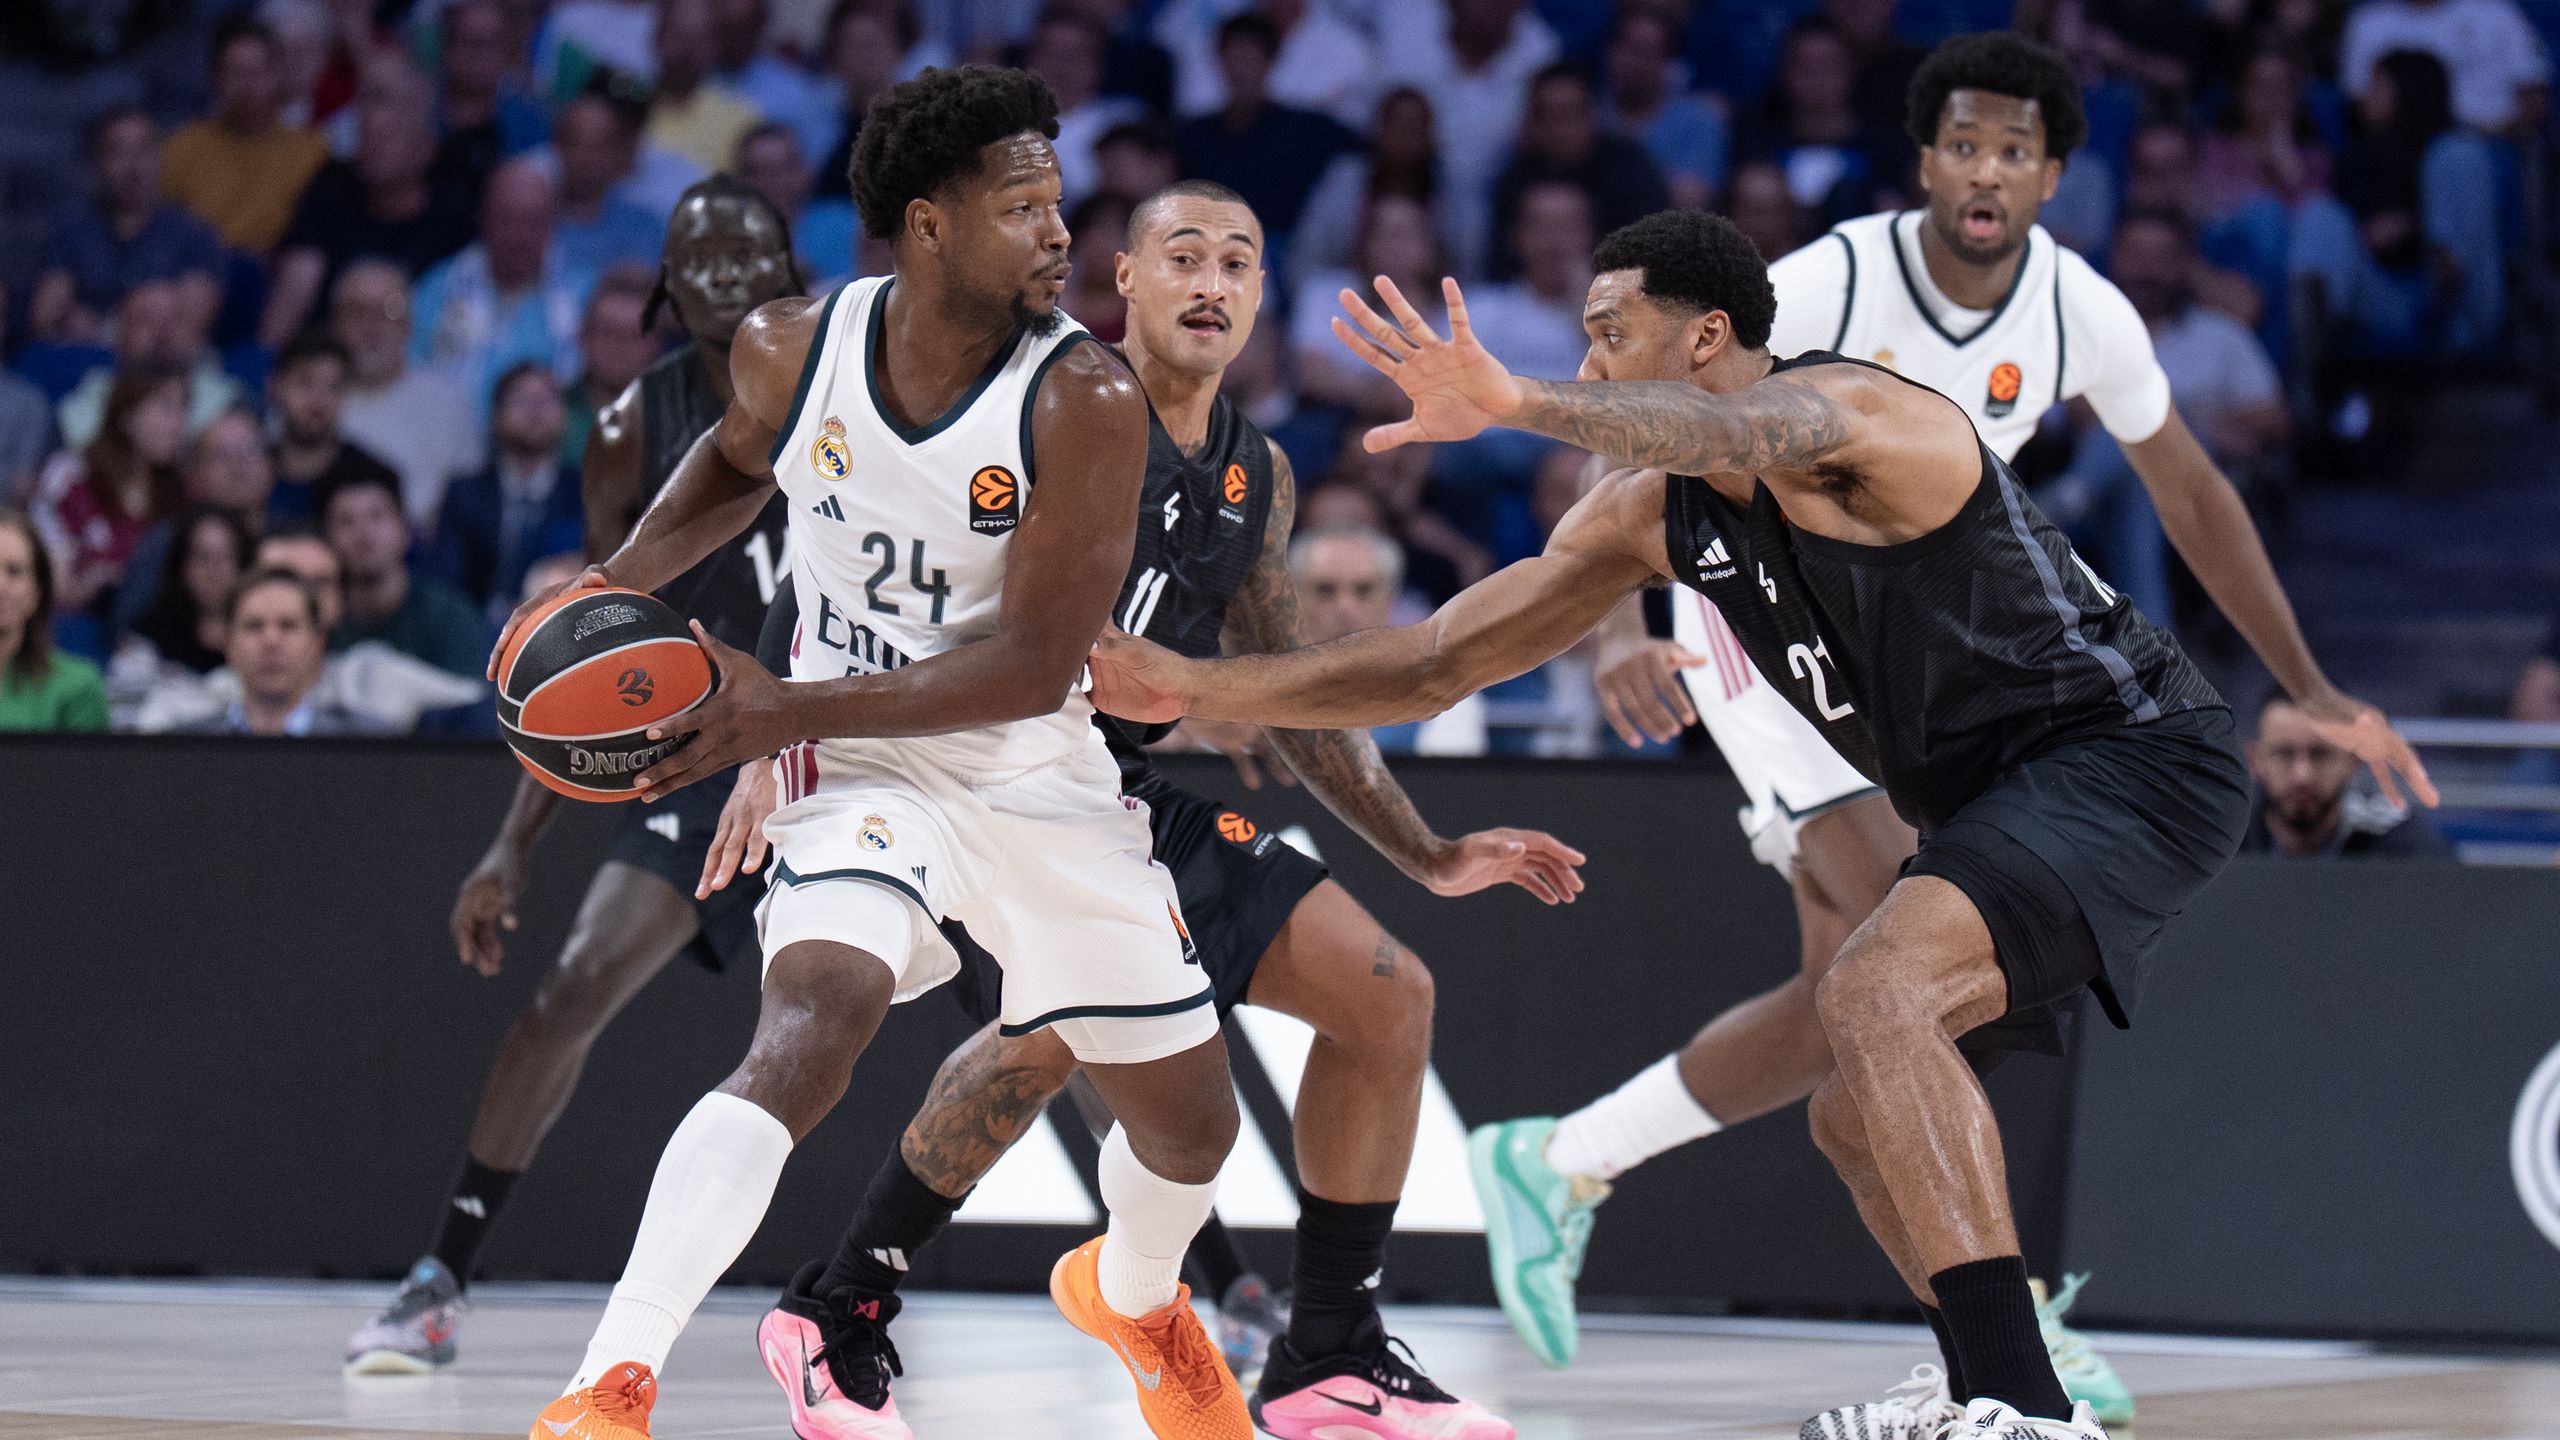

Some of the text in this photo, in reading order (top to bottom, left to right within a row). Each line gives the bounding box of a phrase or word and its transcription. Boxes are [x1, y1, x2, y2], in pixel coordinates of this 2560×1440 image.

[972, 519, 1016, 528] ETIHAD
[861, 531, 951, 626] 24
[1123, 567, 1169, 637] 11
